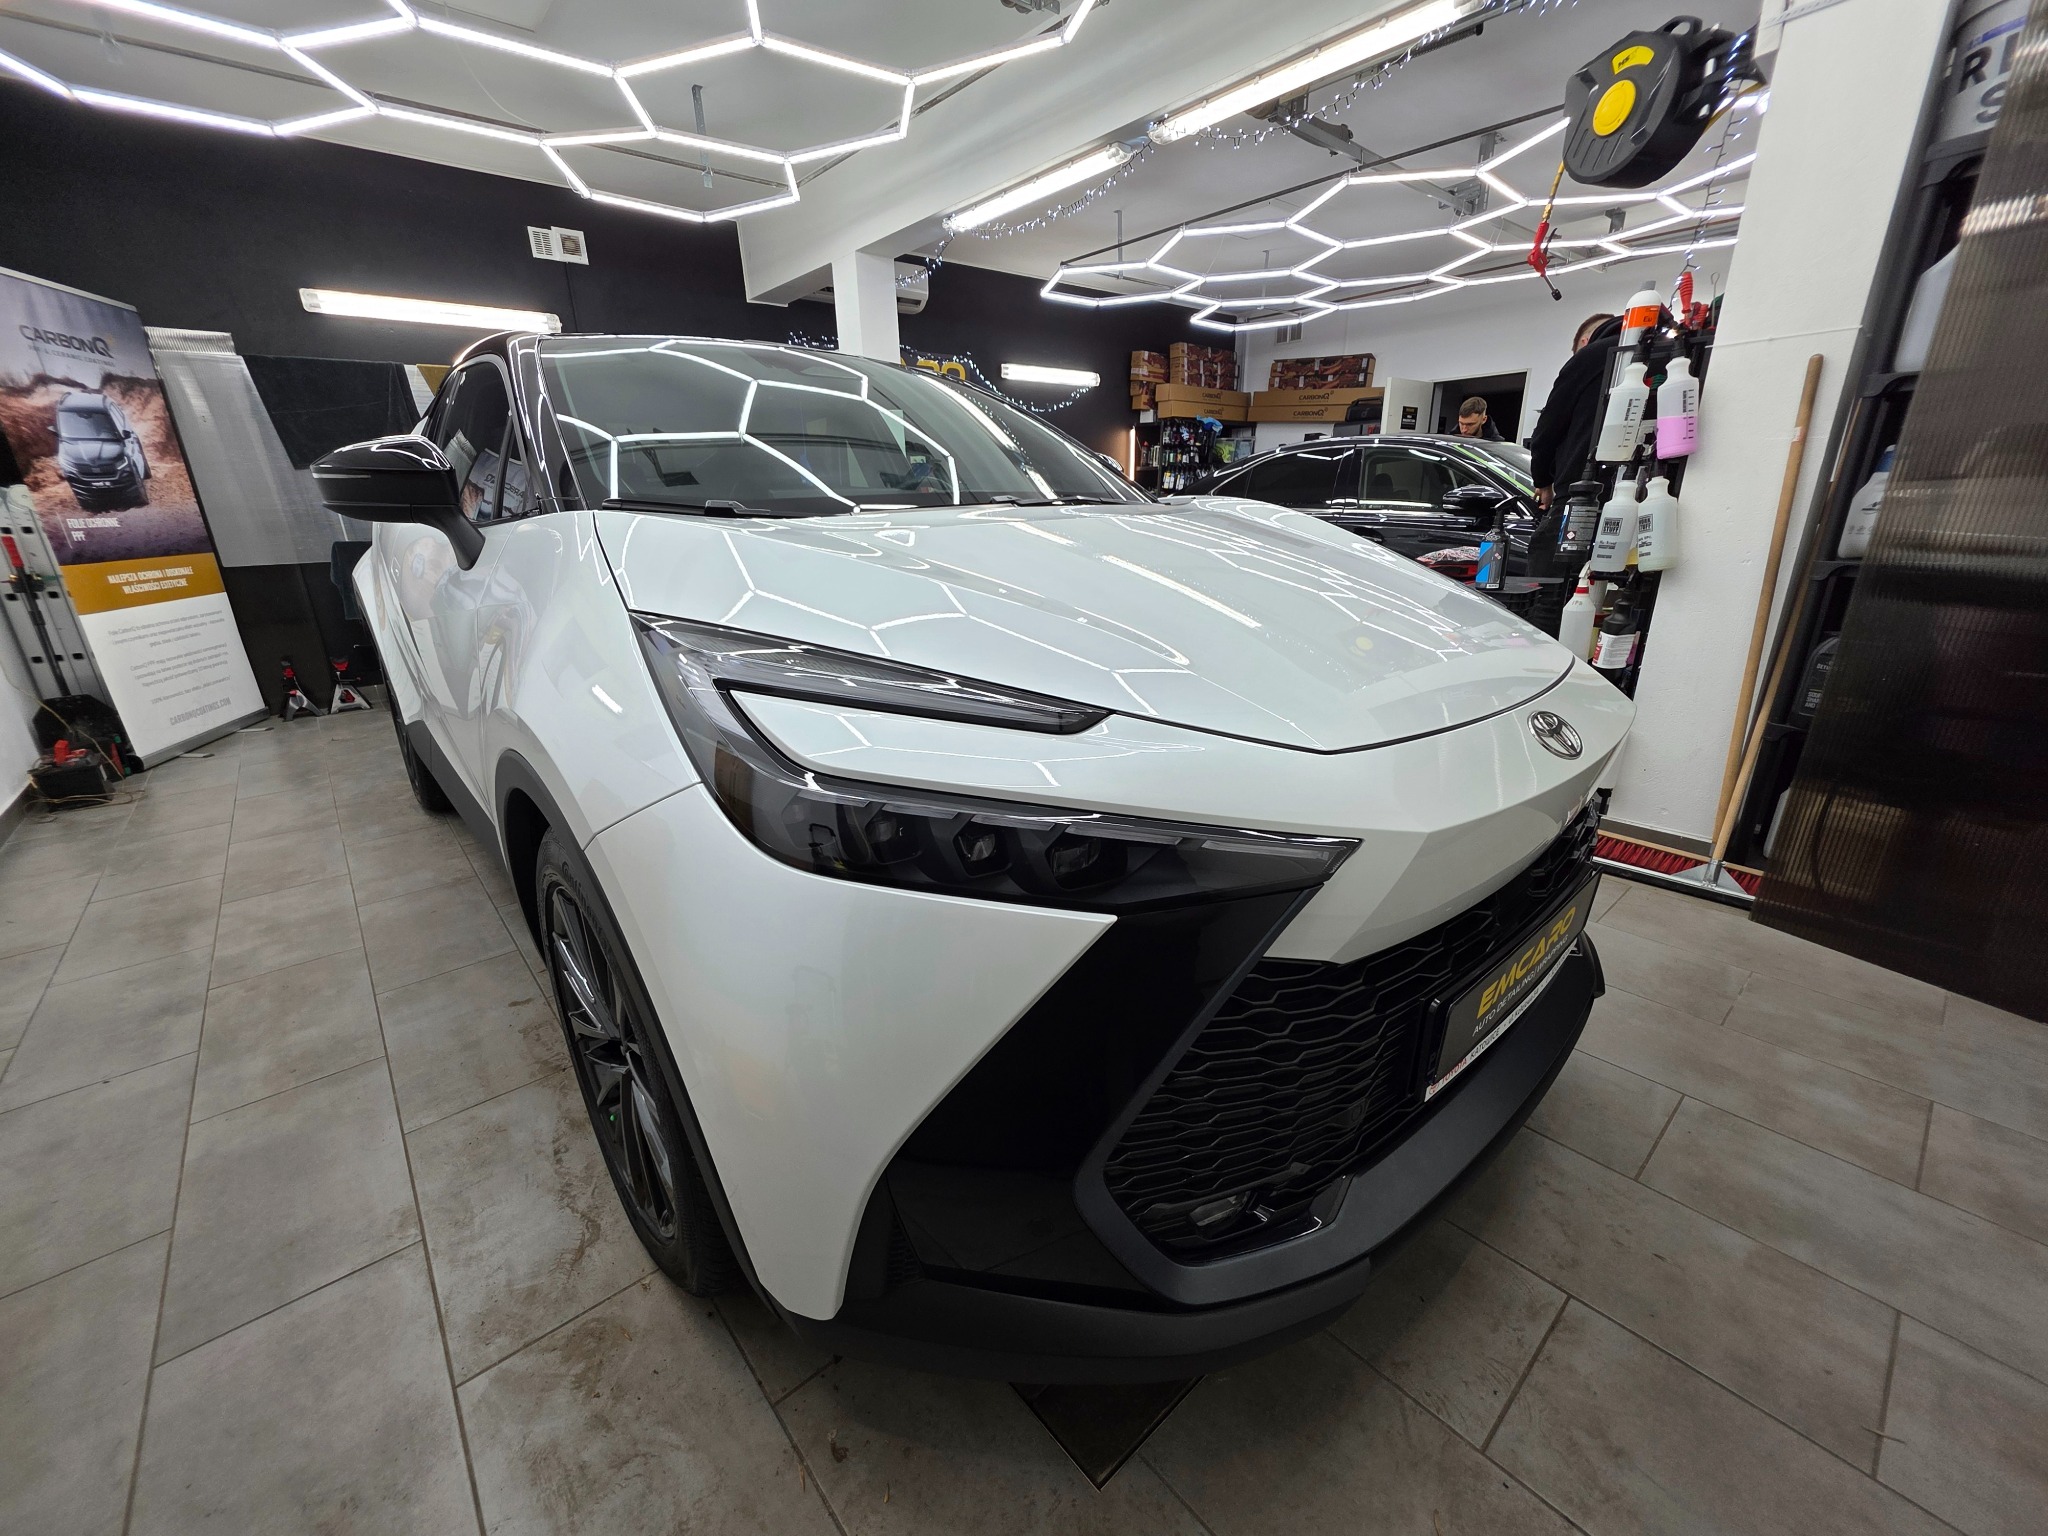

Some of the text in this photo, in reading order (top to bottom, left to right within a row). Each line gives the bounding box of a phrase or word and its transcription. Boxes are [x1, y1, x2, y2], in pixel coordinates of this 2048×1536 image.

[18, 324, 114, 359] CARBONQ
[1299, 392, 1330, 401] CARBONQ
[1293, 409, 1324, 417] CARBONQ
[66, 517, 122, 529] FOLIE OCHRONNE
[71, 530, 86, 541] PPF
[1477, 906, 1576, 1020] EMCARO
[1472, 1008, 1496, 1037] AUTO
[1441, 1027, 1501, 1084] TOYOTA KATOWICE
